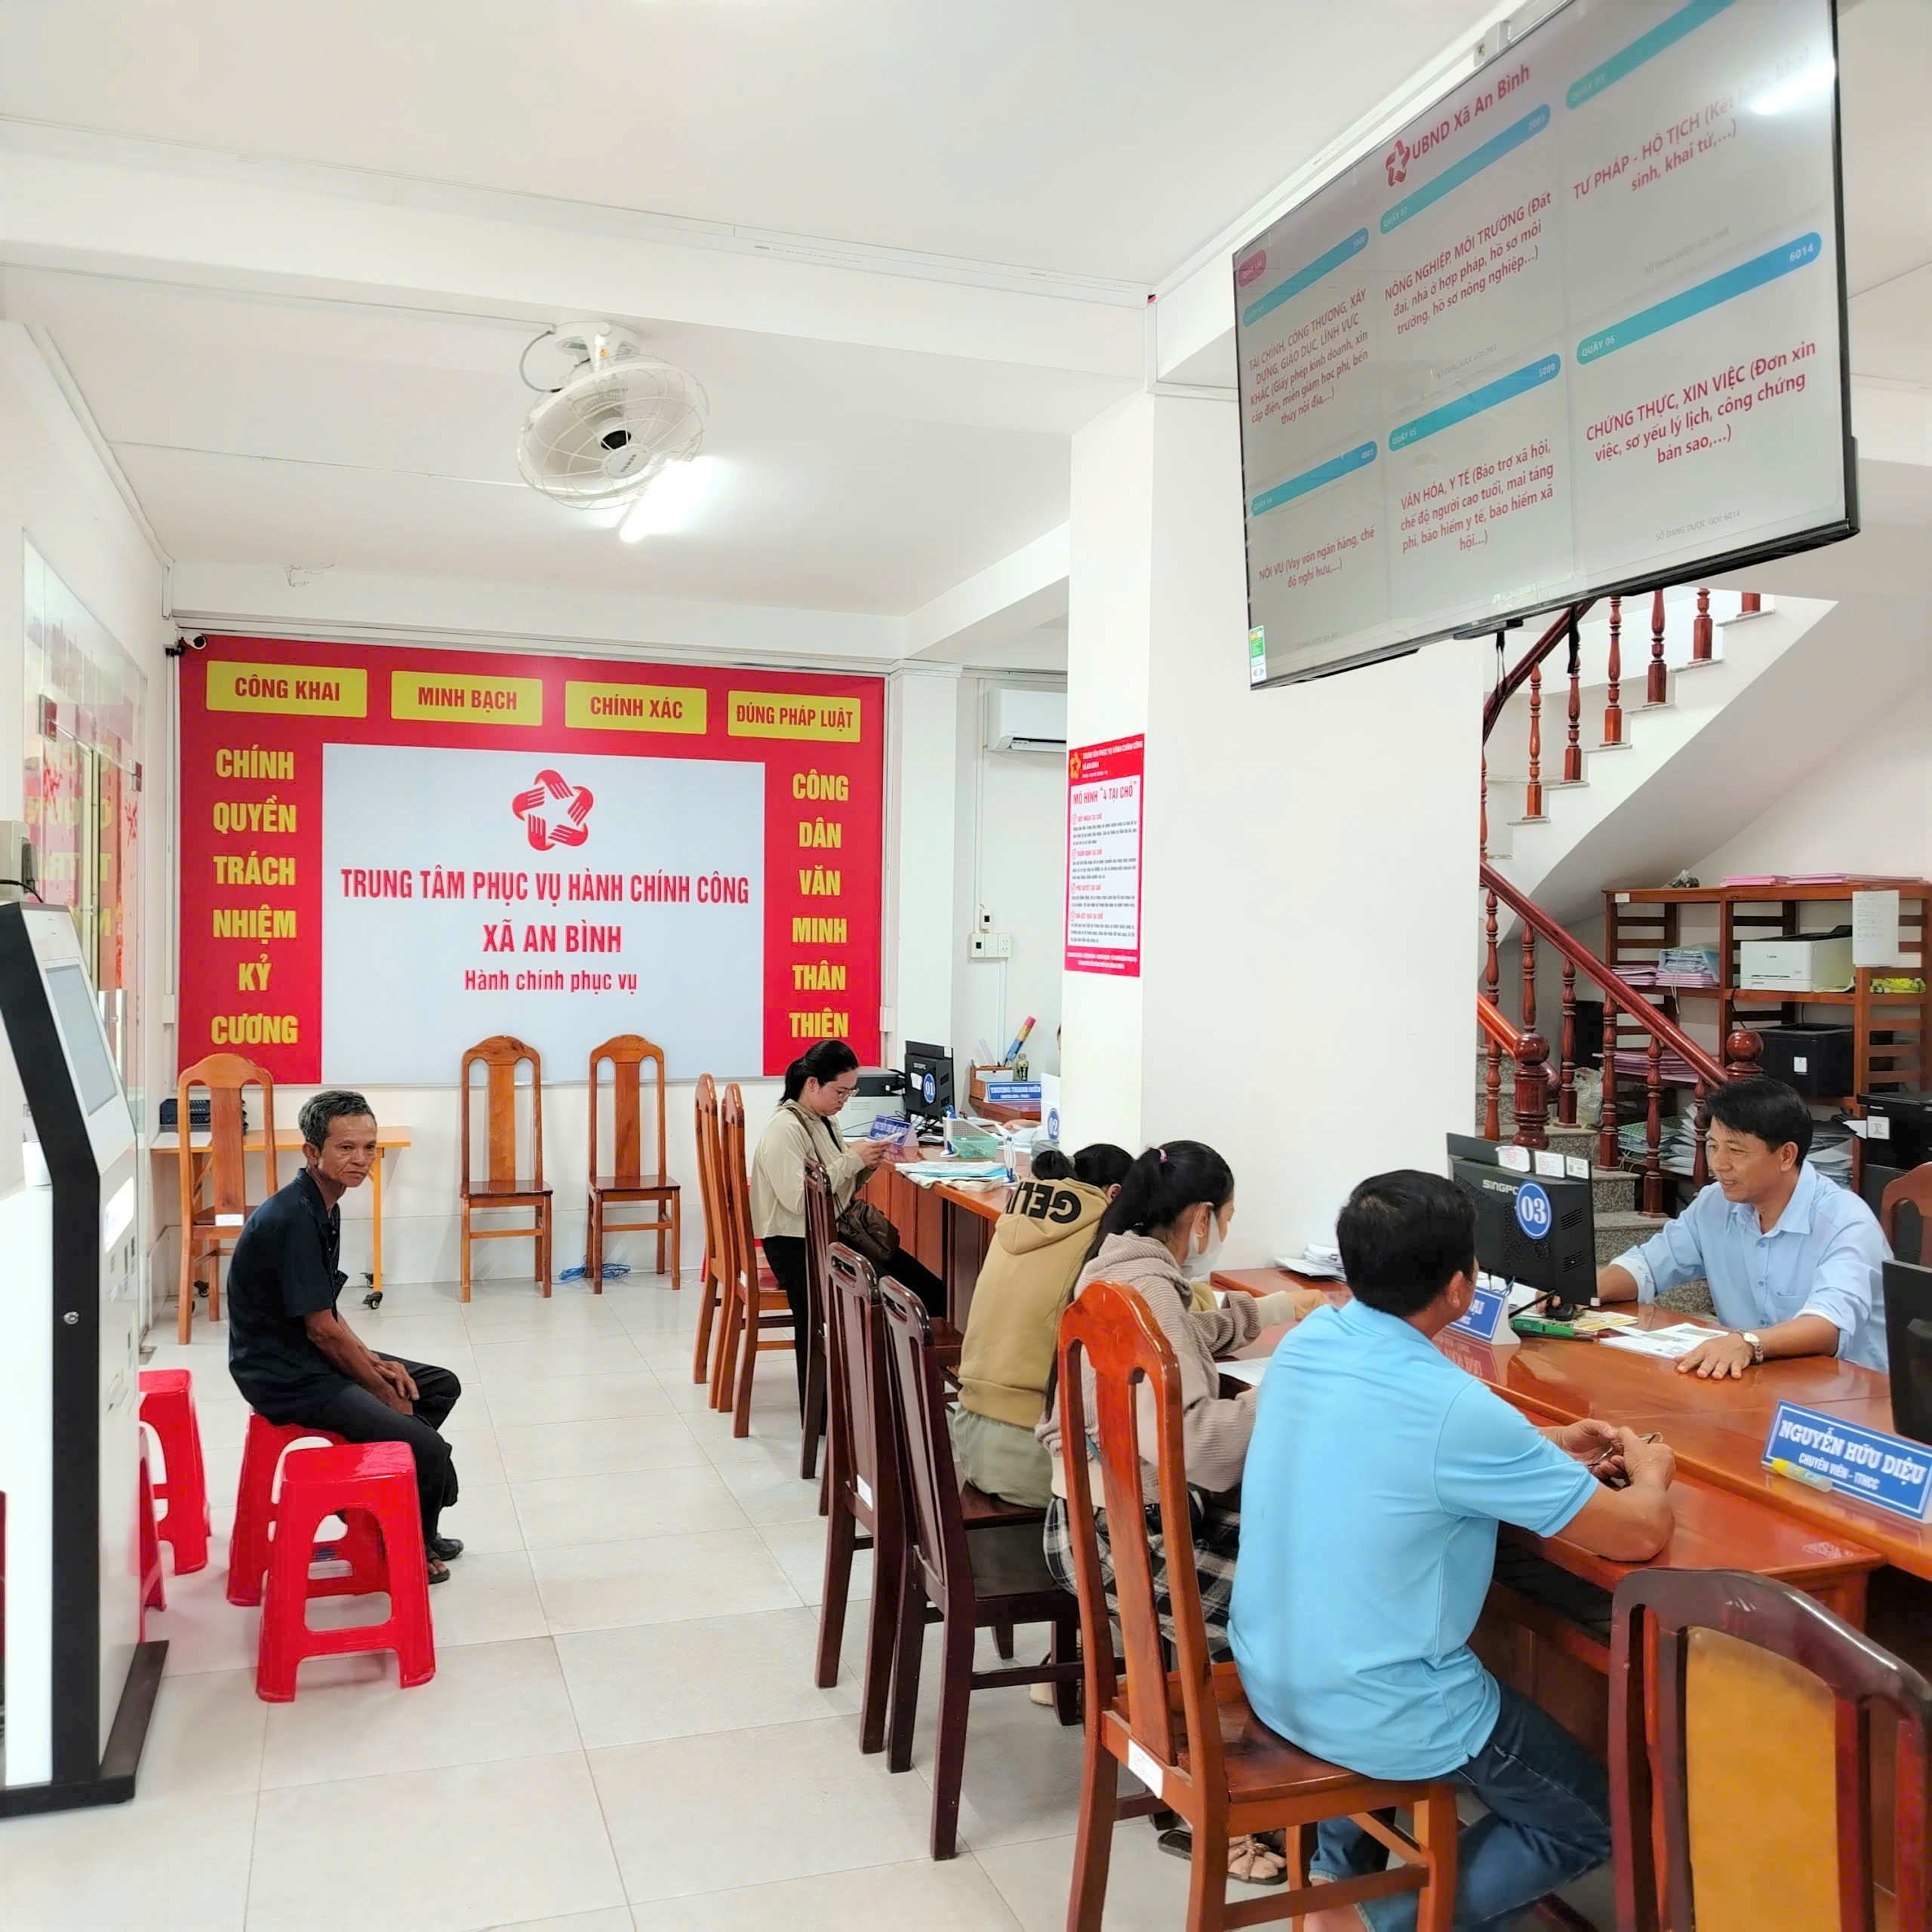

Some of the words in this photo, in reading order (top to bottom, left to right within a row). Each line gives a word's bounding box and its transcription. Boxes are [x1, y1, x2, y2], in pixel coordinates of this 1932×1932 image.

[1413, 121, 1450, 159] UBND
[1454, 106, 1470, 131] Xã
[1475, 94, 1493, 116] An
[1498, 64, 1530, 100] Bình
[1574, 176, 1590, 199] TƯ
[1594, 155, 1629, 189] PHÁP
[1642, 134, 1663, 160] HỘ
[1666, 113, 1700, 144] TỊCH
[1631, 166, 1661, 192] sinh,
[1665, 143, 1694, 173] khai
[1385, 275, 1413, 302] NÔNG
[1454, 235, 1475, 260] MÔI
[1478, 205, 1524, 245] TRƯỜNG
[1527, 192, 1552, 218] (Đất
[1789, 243, 1814, 263] 6014
[1393, 300, 1410, 316] đai,
[1411, 285, 1428, 308] nhà
[1430, 281, 1437, 295] ở
[1439, 272, 1457, 291] hợp
[1460, 256, 1487, 280] pháp,
[1490, 243, 1503, 261] hồ
[1506, 237, 1518, 252] sơ
[1521, 219, 1542, 244] môi
[1397, 310, 1430, 335] trường,
[1432, 300, 1445, 315] hồ
[1447, 293, 1458, 308] sơ
[1460, 276, 1486, 300] nông
[1605, 334, 1615, 346] 06
[1586, 408, 1633, 441] CHỨNG
[1637, 393, 1678, 423] THỰC,
[1683, 380, 1708, 405] XIN
[1712, 366, 1746, 392] VIỆC
[1750, 351, 1787, 380] (Đơn
[1792, 342, 1816, 362] xin
[1595, 438, 1622, 462] việc,
[1626, 434, 1640, 451] sơ
[1643, 424, 1666, 448] yếu
[1670, 417, 1682, 438] lý
[1686, 405, 1713, 429] lịch,
[1717, 392, 1753, 416] công
[1757, 374, 1806, 401] chứng
[1657, 445, 1682, 464] bản
[1401, 490, 1420, 510] VĂN
[1423, 481, 1447, 502] HÓA,
[1450, 477, 1456, 491] Y
[1458, 467, 1470, 488] TẾ
[1473, 463, 1494, 484] (Bảo
[1497, 456, 1512, 471] trợ
[1515, 448, 1527, 465] xã
[1531, 439, 1551, 459] hội,
[1401, 512, 1416, 531] chế
[1418, 508, 1430, 525] độ
[1432, 497, 1460, 521] người
[1462, 494, 1478, 508] cao
[1481, 480, 1504, 500] tuổi,
[1507, 471, 1526, 491] mai
[1528, 463, 1554, 481] táng
[235, 674, 288, 699] CÔNG
[295, 681, 340, 702] KHAI
[418, 687, 465, 708] MINH
[471, 689, 518, 713] BẠCH
[590, 694, 644, 717] CHÍNH
[650, 697, 683, 719] XÁC
[737, 702, 775, 724] ĐÚNG
[780, 705, 816, 727] PHÁP
[820, 709, 854, 732] LUẬT
[216, 744, 294, 780] CHÍNH
[792, 768, 849, 801] CÔNG
[213, 795, 297, 835] QUYỀN
[799, 817, 841, 848] DÂN
[214, 851, 296, 886] TRÁCH
[798, 864, 840, 896] VĂN
[340, 869, 413, 898] TRUNG
[420, 865, 466, 899] TÂM
[472, 872, 528, 906] PHỤC
[535, 872, 561, 907] VỤ
[568, 868, 623, 902] HÀNH
[630, 869, 691, 903] CHÍNH
[697, 870, 749, 904] CÔNG
[213, 904, 297, 945] NHIỆM
[482, 919, 515, 952] XÃ
[523, 925, 556, 952] AN
[565, 919, 621, 952] BÌNH
[792, 917, 848, 943] MINH
[238, 954, 271, 992] KỶ
[465, 969, 509, 990] Hành
[515, 969, 564, 990] chính
[571, 970, 612, 995] phục
[618, 974, 637, 995] vụ
[792, 959, 846, 991] THÂN
[211, 1013, 298, 1044] CƯƠNG
[925, 1081, 934, 1096] 01
[1049, 1118, 1058, 1135] 02
[1521, 1196, 1546, 1224] 03
[1779, 1420, 1844, 1457] NGUYỄN
[1843, 1441, 1883, 1469] HỮU
[1881, 1457, 1927, 1485] DIỆU
